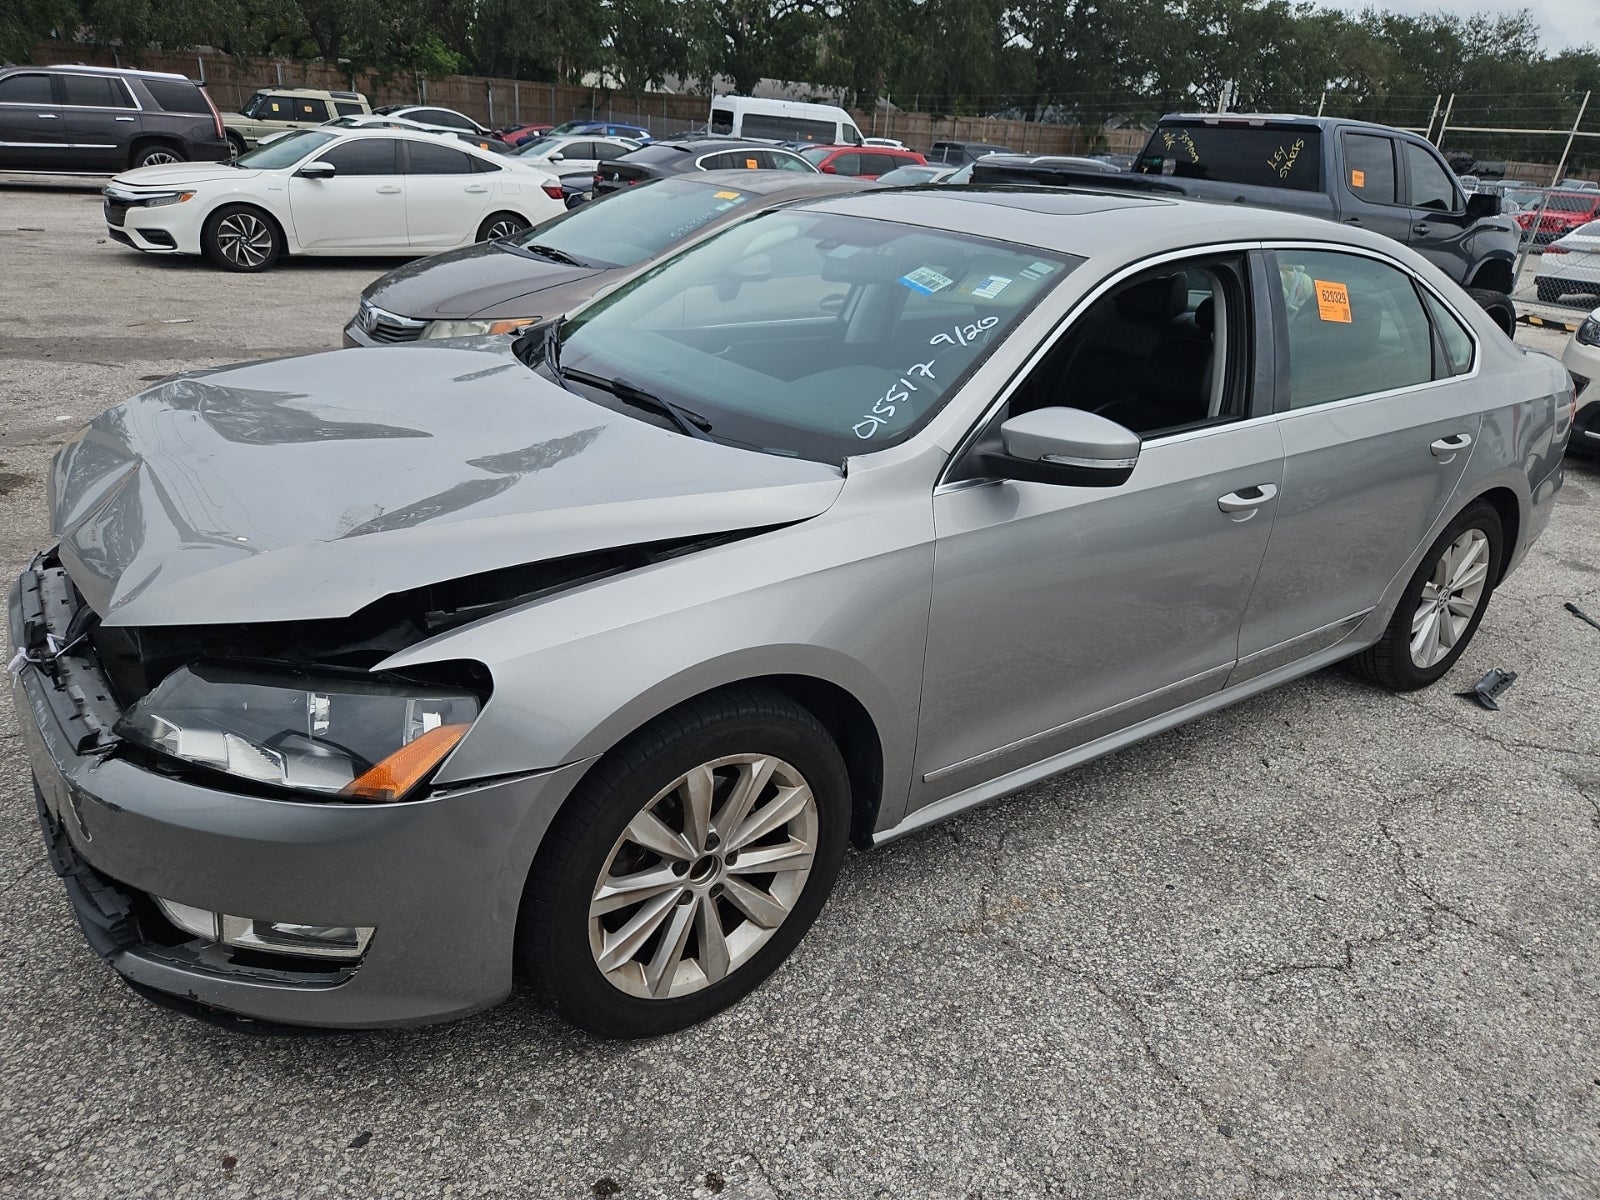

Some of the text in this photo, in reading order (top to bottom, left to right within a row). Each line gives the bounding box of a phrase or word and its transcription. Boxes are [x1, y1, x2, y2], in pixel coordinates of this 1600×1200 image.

[1266, 145, 1289, 171] KEY
[1279, 138, 1305, 178] STARTS
[852, 316, 999, 440] 015517 9/20
